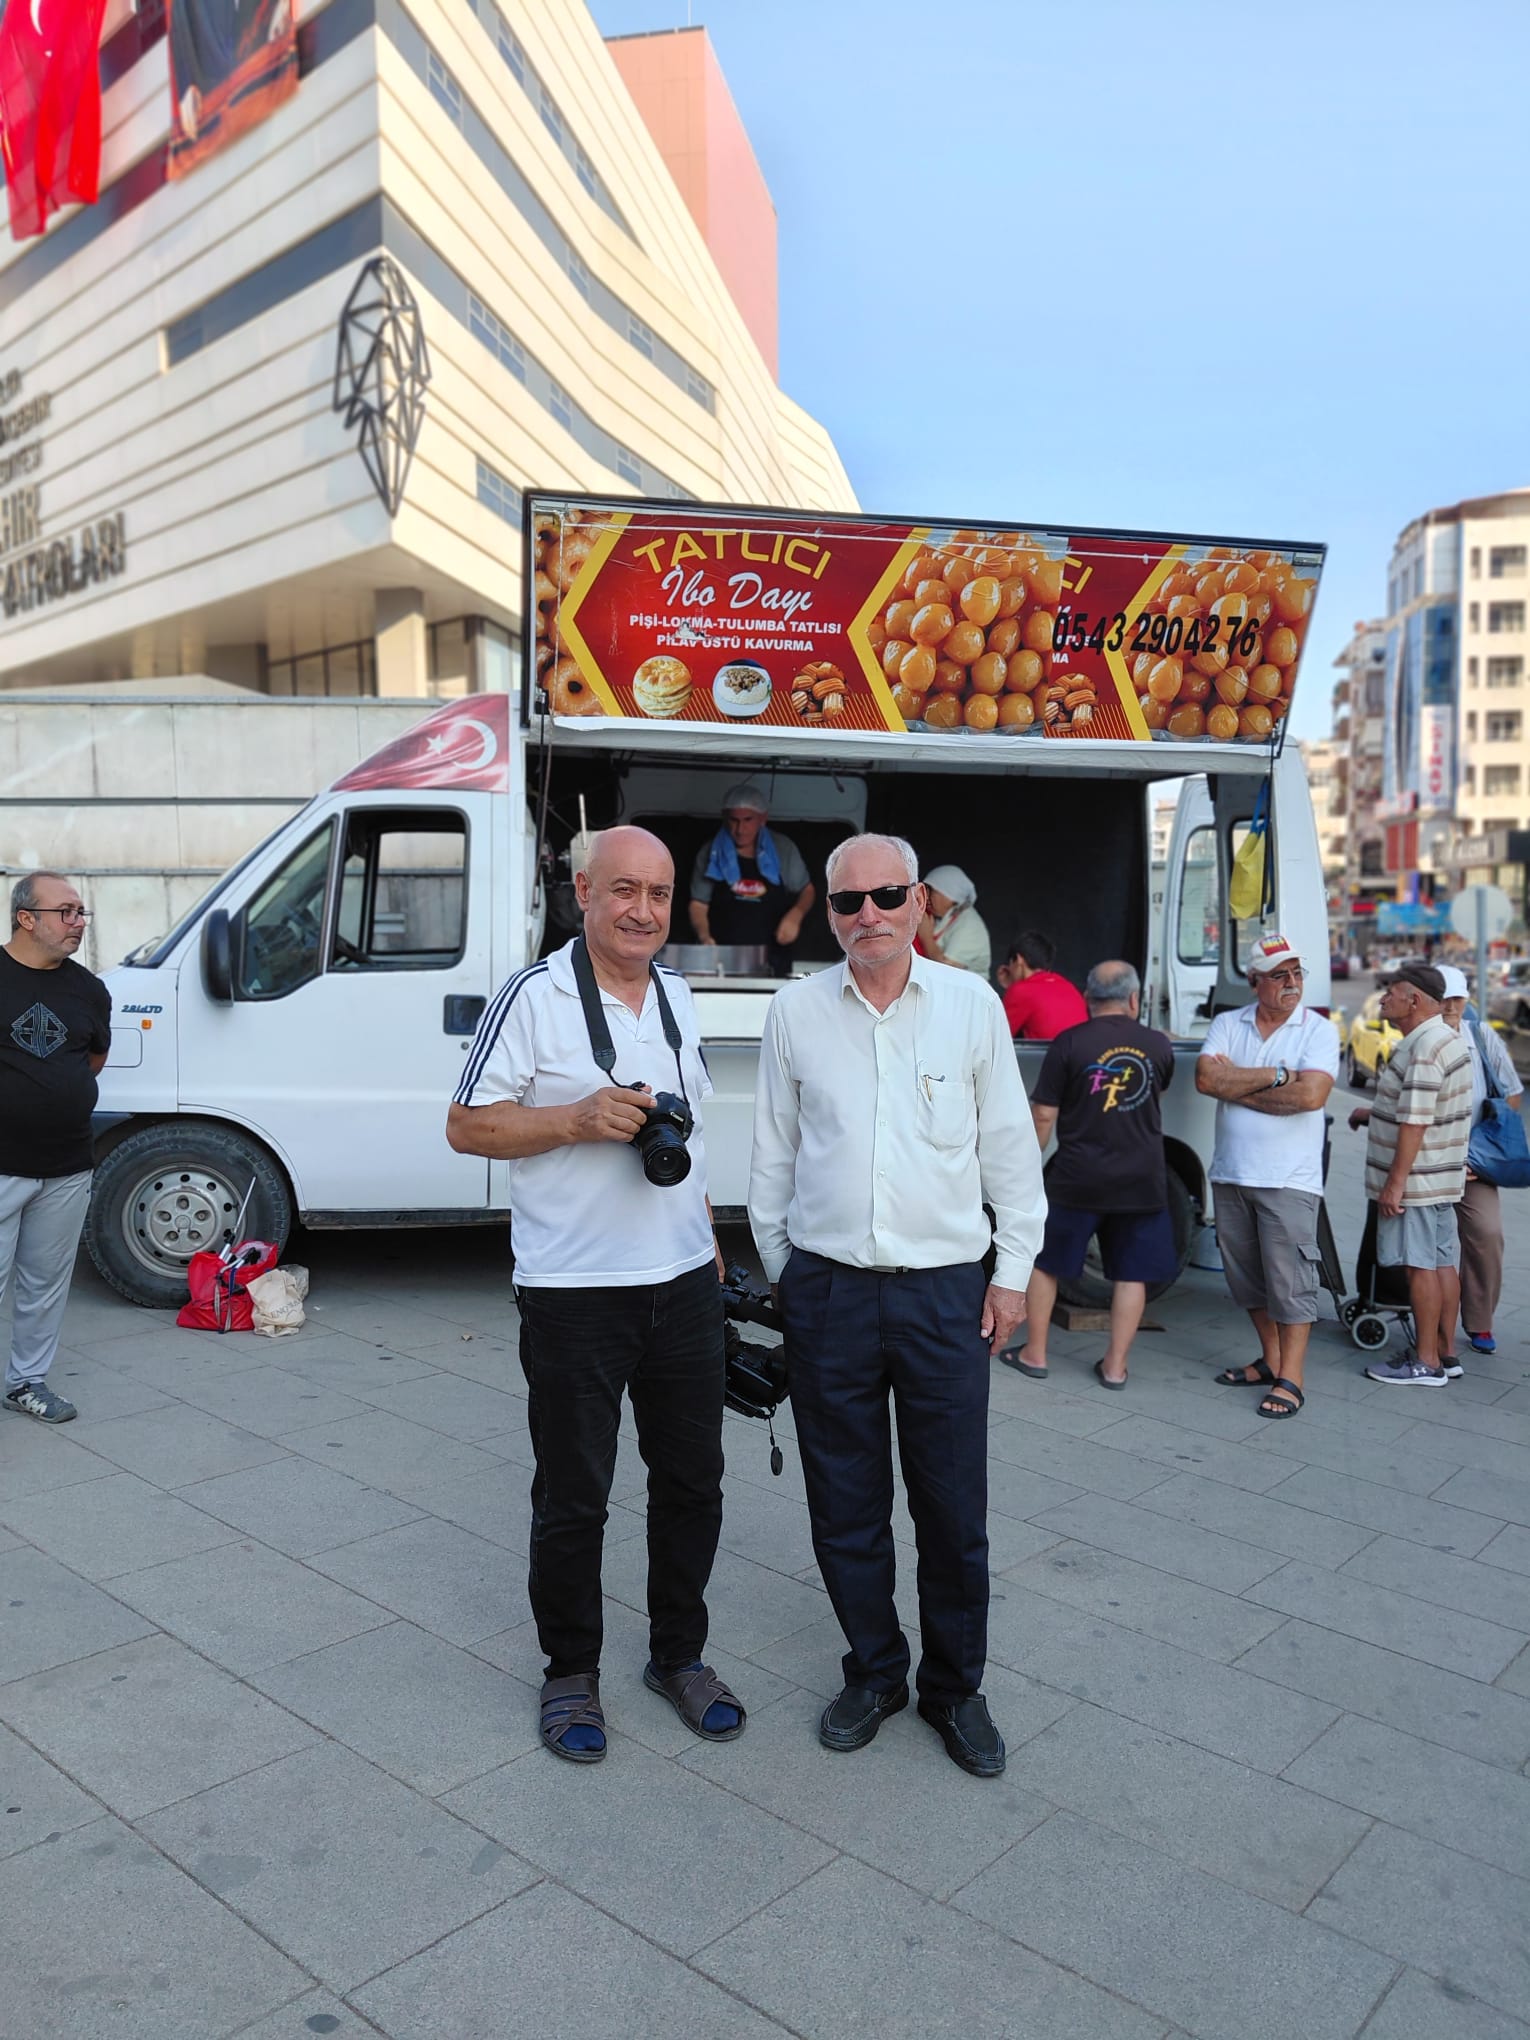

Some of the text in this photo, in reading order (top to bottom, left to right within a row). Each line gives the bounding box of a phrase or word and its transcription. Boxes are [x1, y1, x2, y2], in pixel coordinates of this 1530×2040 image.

[633, 529, 832, 581] TATLICI
[661, 563, 813, 621] İbo Dayı
[744, 638, 815, 652] KAVURMA
[789, 621, 842, 634] TATLISI
[1052, 612, 1127, 656] 0543
